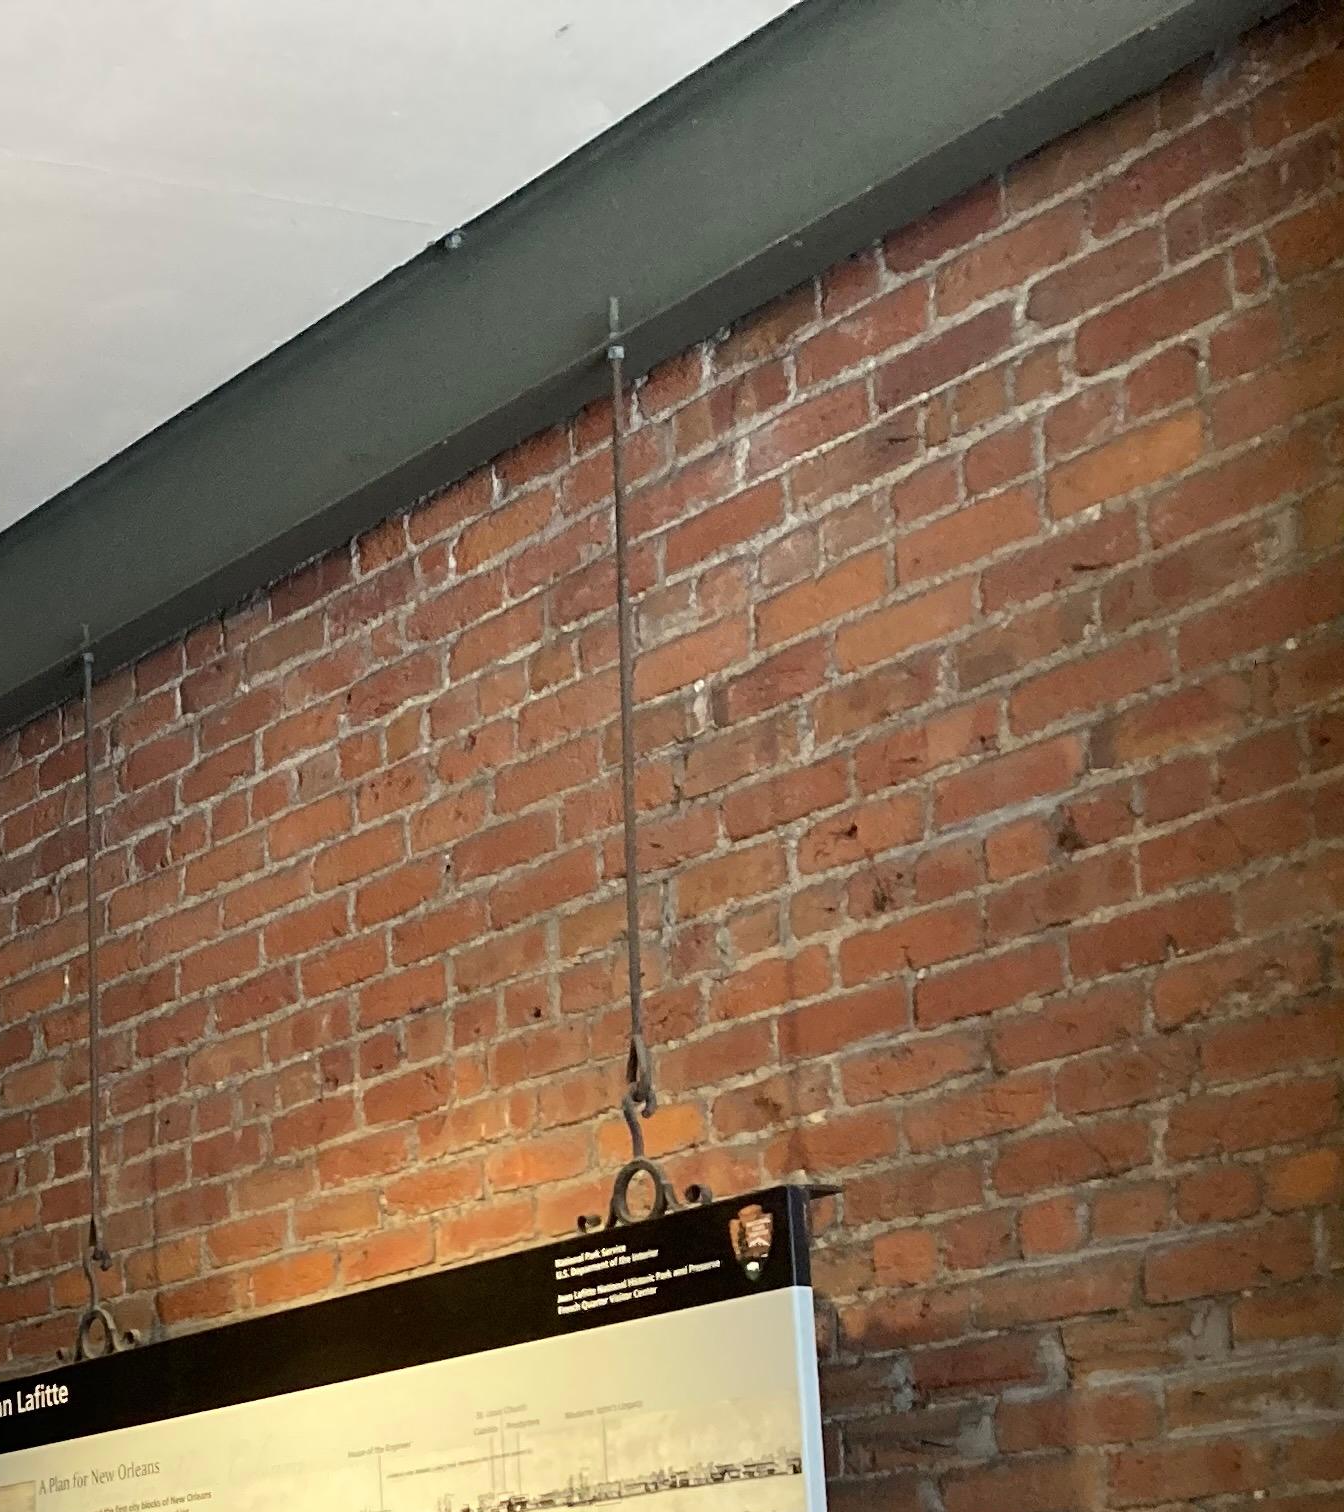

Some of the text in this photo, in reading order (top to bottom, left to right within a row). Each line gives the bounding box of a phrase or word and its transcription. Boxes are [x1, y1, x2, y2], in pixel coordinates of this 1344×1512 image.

[17, 1383, 69, 1414] Lafitte
[49, 1475, 70, 1493] Plan
[72, 1472, 87, 1488] for
[91, 1470, 114, 1484] New
[117, 1461, 160, 1480] Orleans
